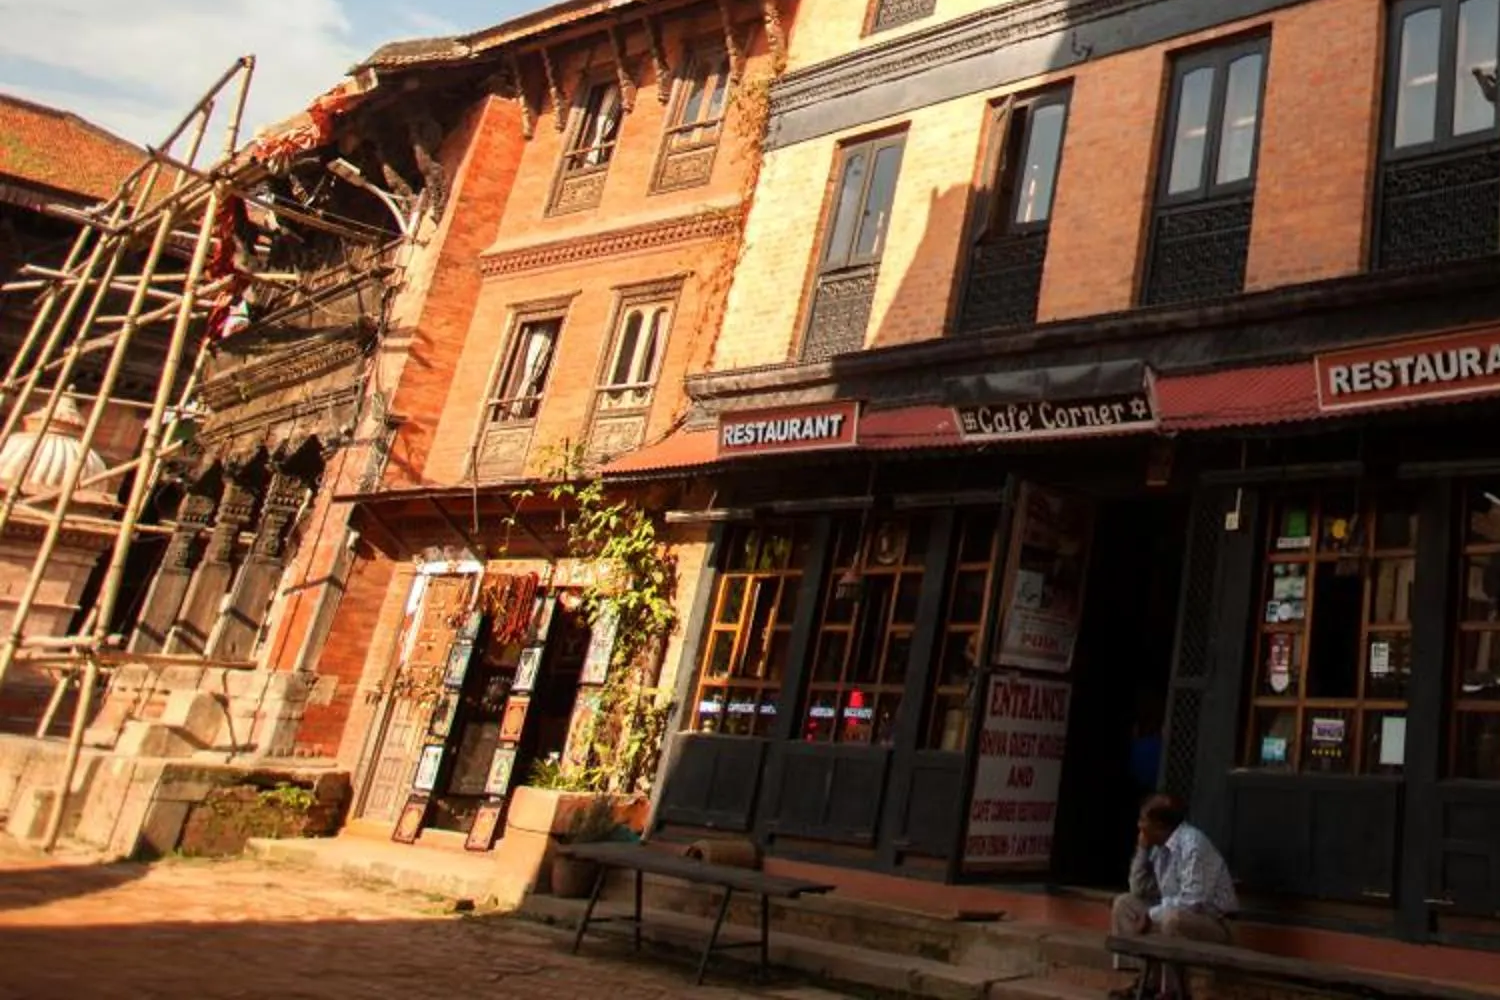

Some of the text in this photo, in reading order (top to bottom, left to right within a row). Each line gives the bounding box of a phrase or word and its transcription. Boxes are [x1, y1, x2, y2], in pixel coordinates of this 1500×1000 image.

[723, 413, 844, 446] RESTAURANT
[1039, 401, 1125, 430] Corner
[990, 682, 1068, 721] ENTRANCE
[1007, 765, 1034, 788] AND
